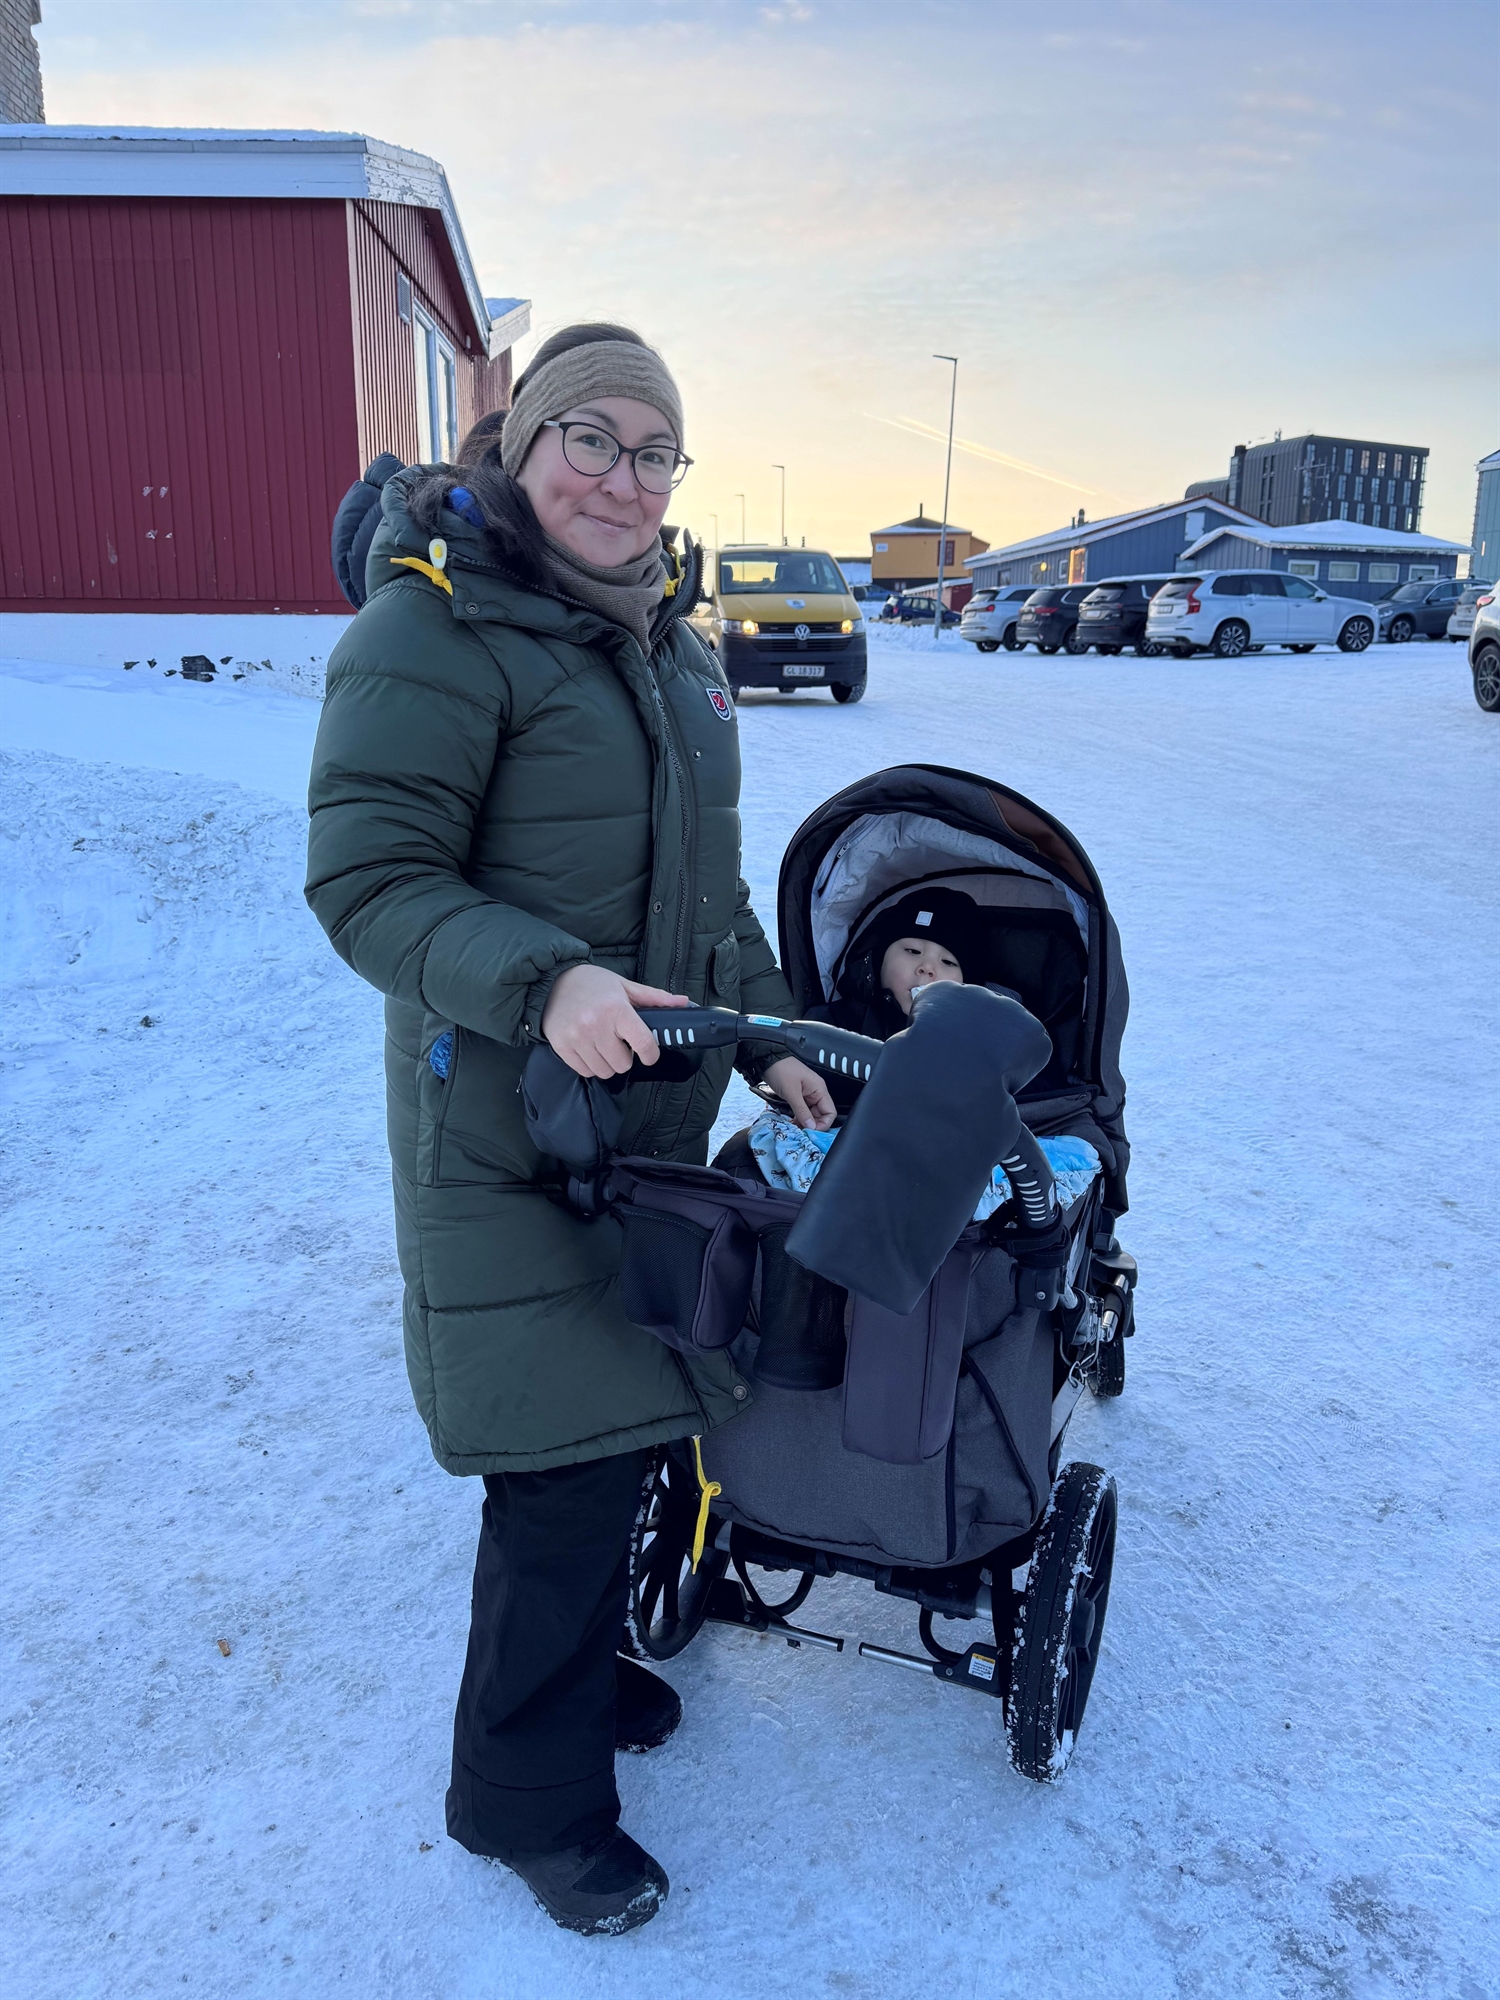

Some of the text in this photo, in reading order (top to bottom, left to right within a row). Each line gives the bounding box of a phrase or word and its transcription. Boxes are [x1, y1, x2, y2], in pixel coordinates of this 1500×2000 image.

[795, 624, 810, 640] VW
[786, 666, 796, 675] GL
[808, 667, 822, 675] 317
